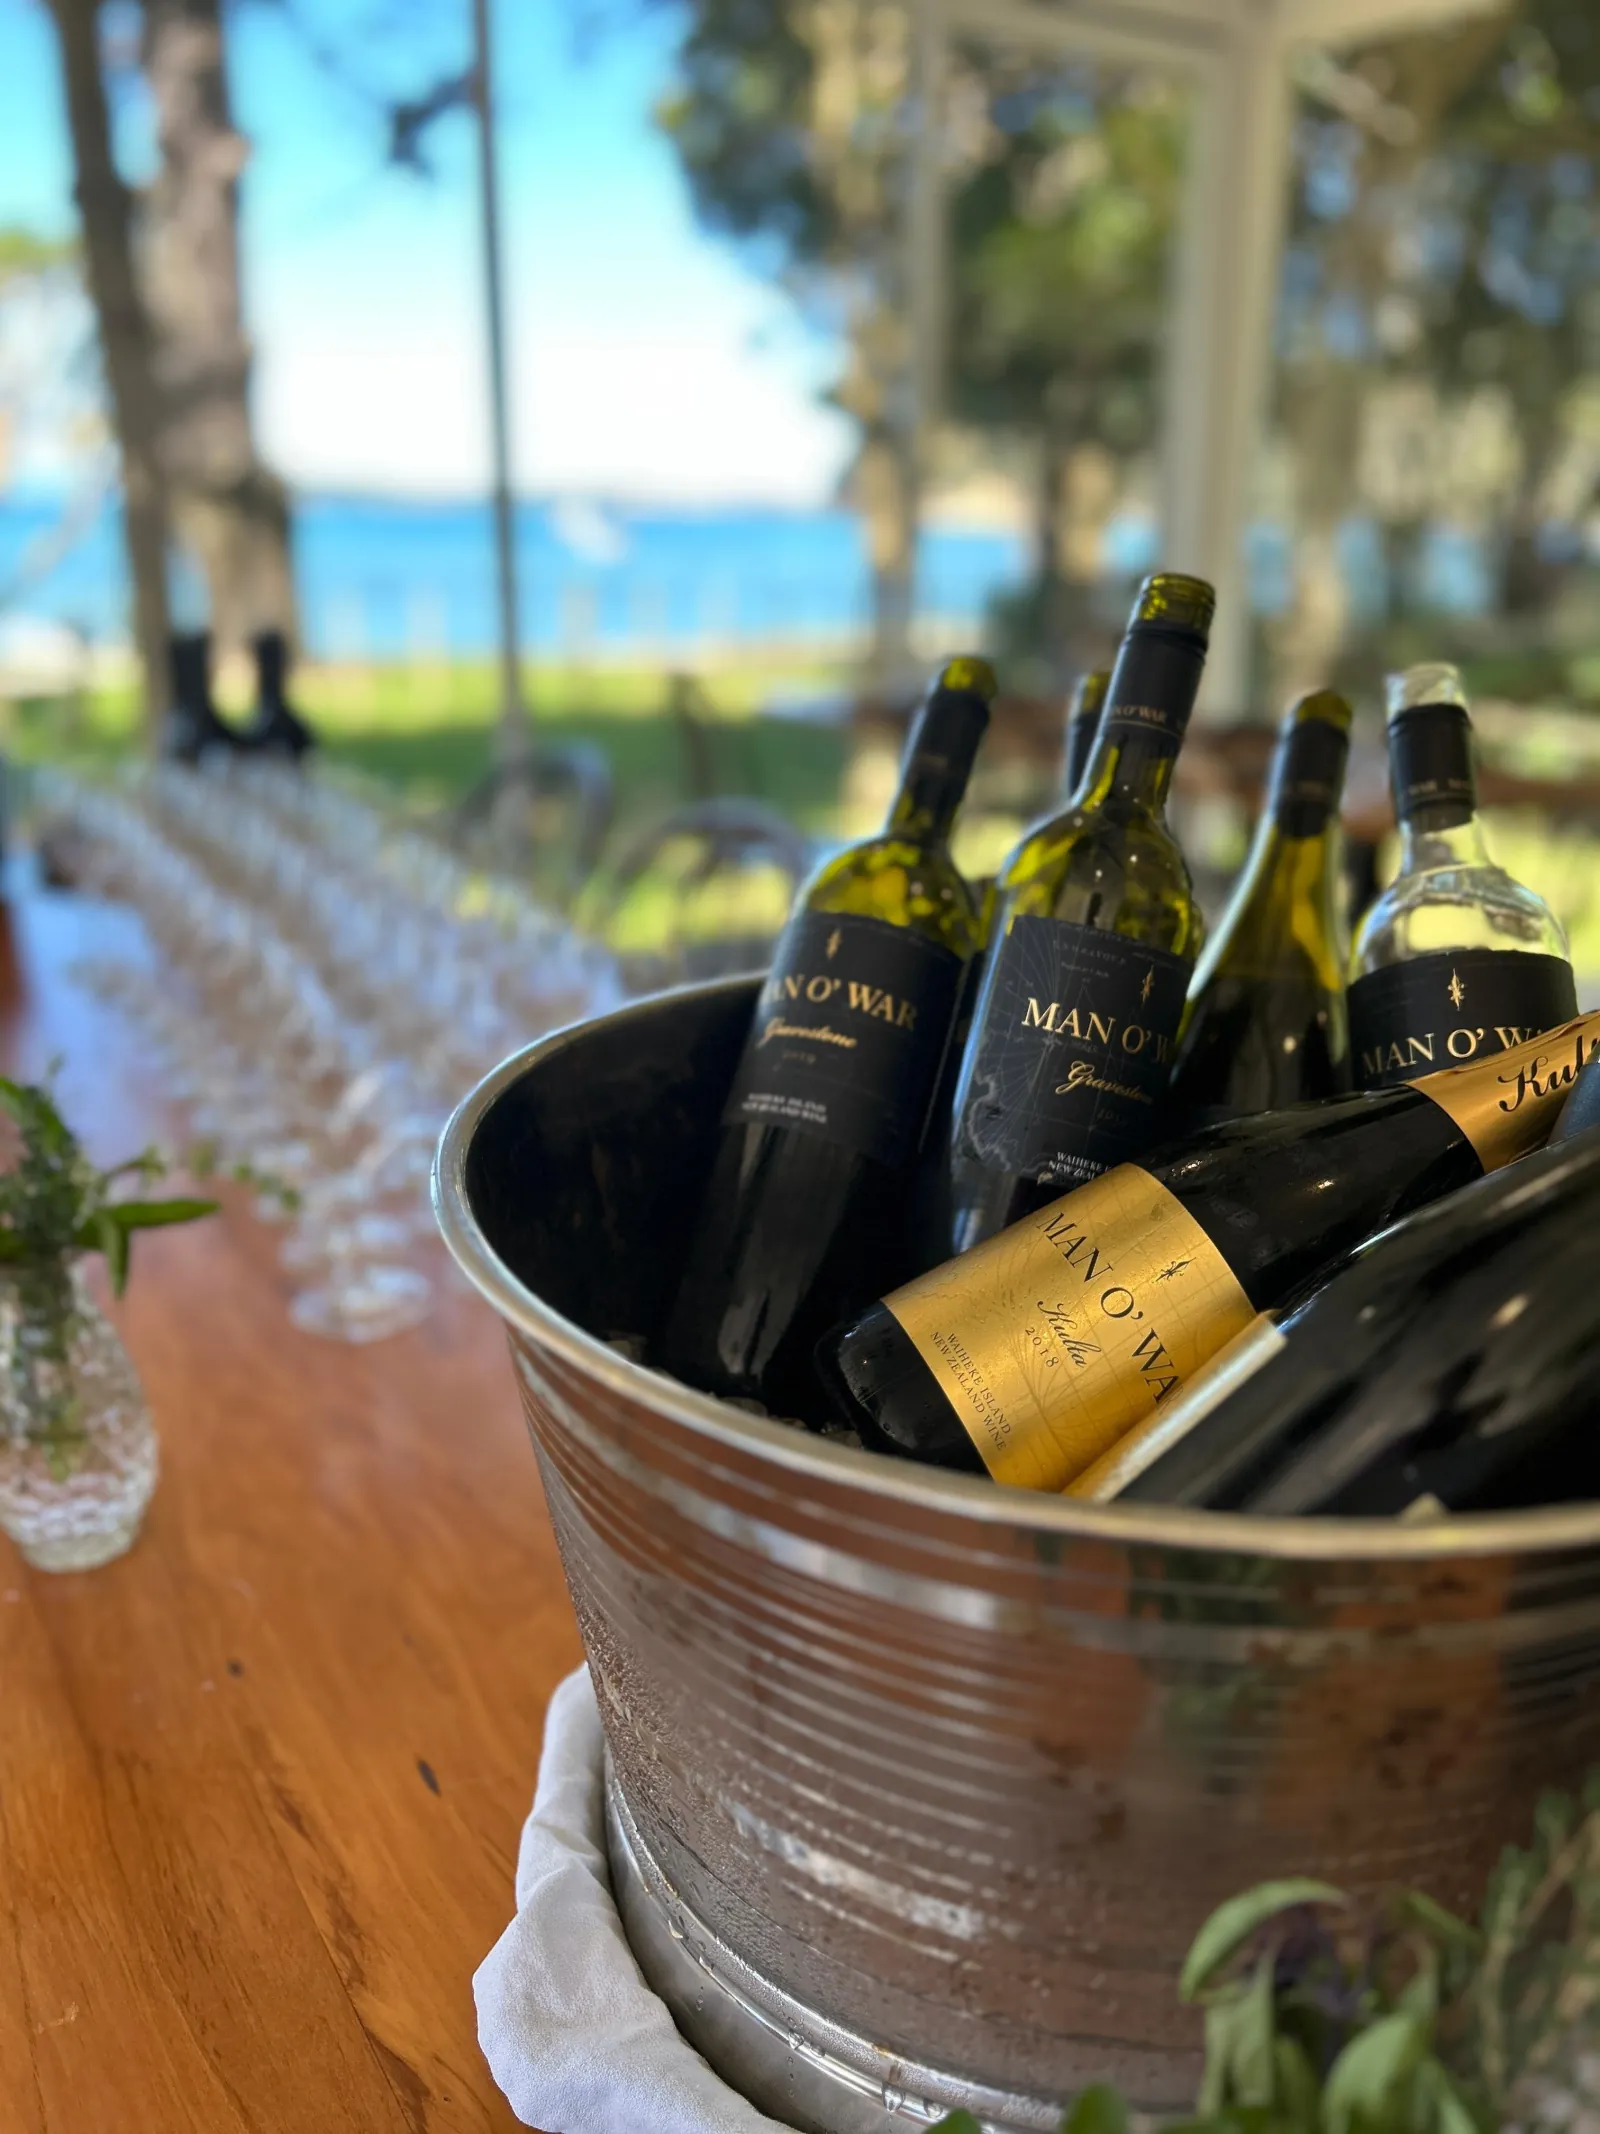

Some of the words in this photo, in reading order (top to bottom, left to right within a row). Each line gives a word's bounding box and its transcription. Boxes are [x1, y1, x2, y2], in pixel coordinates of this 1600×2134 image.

[806, 975, 842, 1003] O'
[848, 981, 918, 1032] WAR
[1021, 997, 1117, 1045] MAN
[1121, 1024, 1152, 1055] O'
[1363, 1032, 1436, 1080] MAN
[1447, 1028, 1487, 1059] O'
[1497, 1034, 1598, 1113] Kul
[1049, 1161, 1071, 1174] NEW
[1074, 1165, 1096, 1180] ZEAL
[1057, 1151, 1103, 1172] WAIHEKE
[1036, 1212, 1114, 1283] MAN
[1100, 1286, 1144, 1321] O'
[1025, 1326, 1060, 1367] 2018
[1037, 1300, 1101, 1369] Kulta
[931, 1331, 953, 1356] NEW
[946, 1357, 986, 1413] ZEALAND
[983, 1415, 1007, 1452] WINE
[946, 1333, 984, 1386] WAIHEKE
[980, 1387, 1012, 1435] ISLAND
